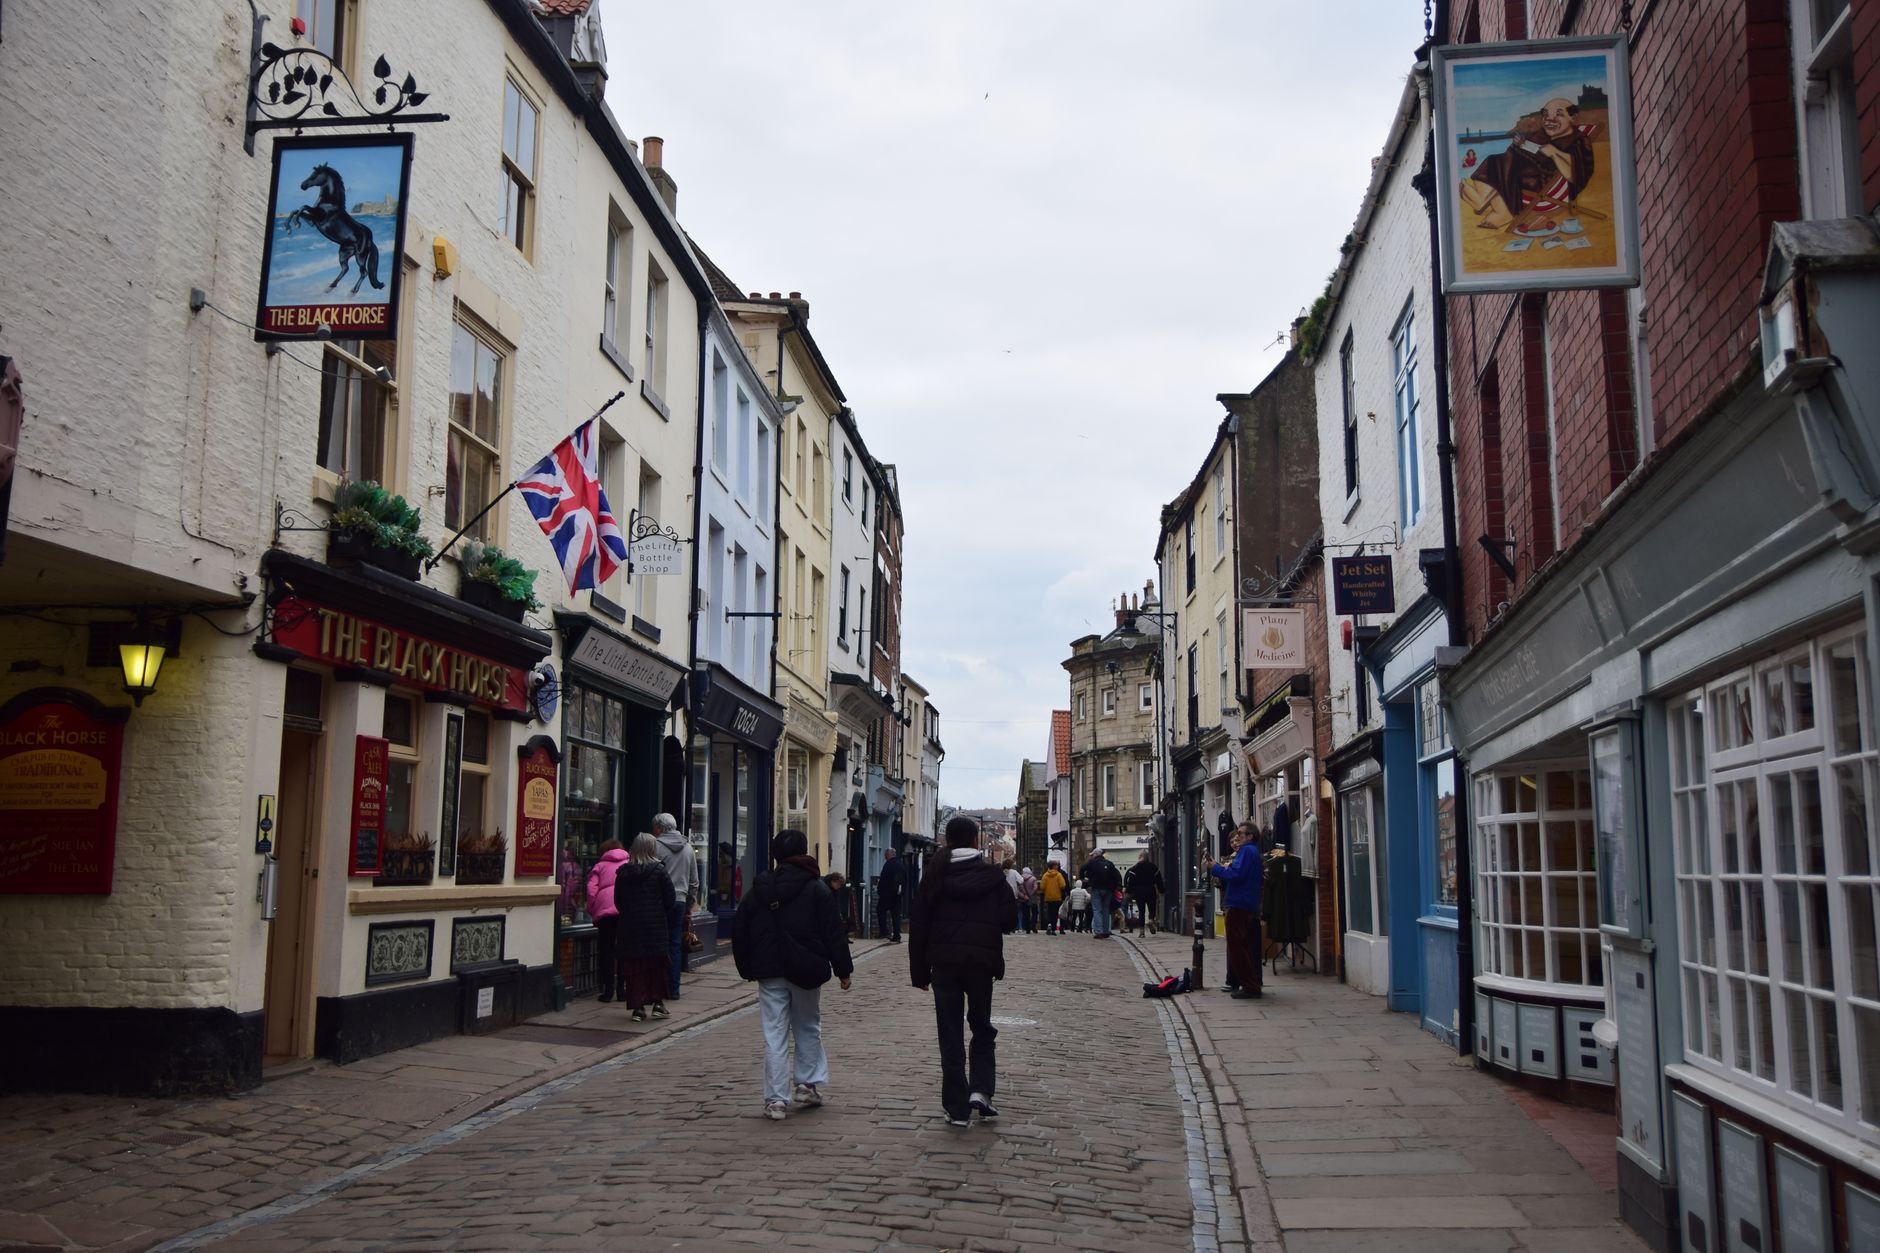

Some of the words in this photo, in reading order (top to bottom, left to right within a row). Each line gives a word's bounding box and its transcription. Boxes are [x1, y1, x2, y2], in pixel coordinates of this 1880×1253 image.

[270, 308, 294, 326] THE
[298, 307, 341, 326] BLACK
[342, 306, 386, 325] HORSE
[631, 543, 650, 553] The
[652, 542, 682, 554] Little
[642, 564, 669, 573] Shop
[1340, 564, 1361, 576] Jet
[1364, 563, 1385, 576] Set
[1342, 581, 1385, 589] Handcrafted
[1351, 590, 1377, 598] Whitby
[1260, 615, 1288, 625] Plant
[319, 607, 372, 666] THE
[374, 626, 448, 687] BLACK
[451, 649, 514, 705] HORSE
[1256, 649, 1296, 661] Medicine
[582, 636, 604, 661] The
[602, 647, 629, 673] Little
[627, 658, 655, 685] Bottle
[652, 670, 674, 693] Shop
[38, 711, 63, 729] The
[733, 706, 760, 736] TOG24
[0, 731, 47, 745] BLACK
[52, 730, 107, 745] HORSE
[14, 763, 86, 777] TRADITIONAL
[51, 839, 72, 850] SUE
[76, 839, 96, 850] IAN
[48, 862, 68, 873] THE
[71, 862, 99, 873] TEAM
